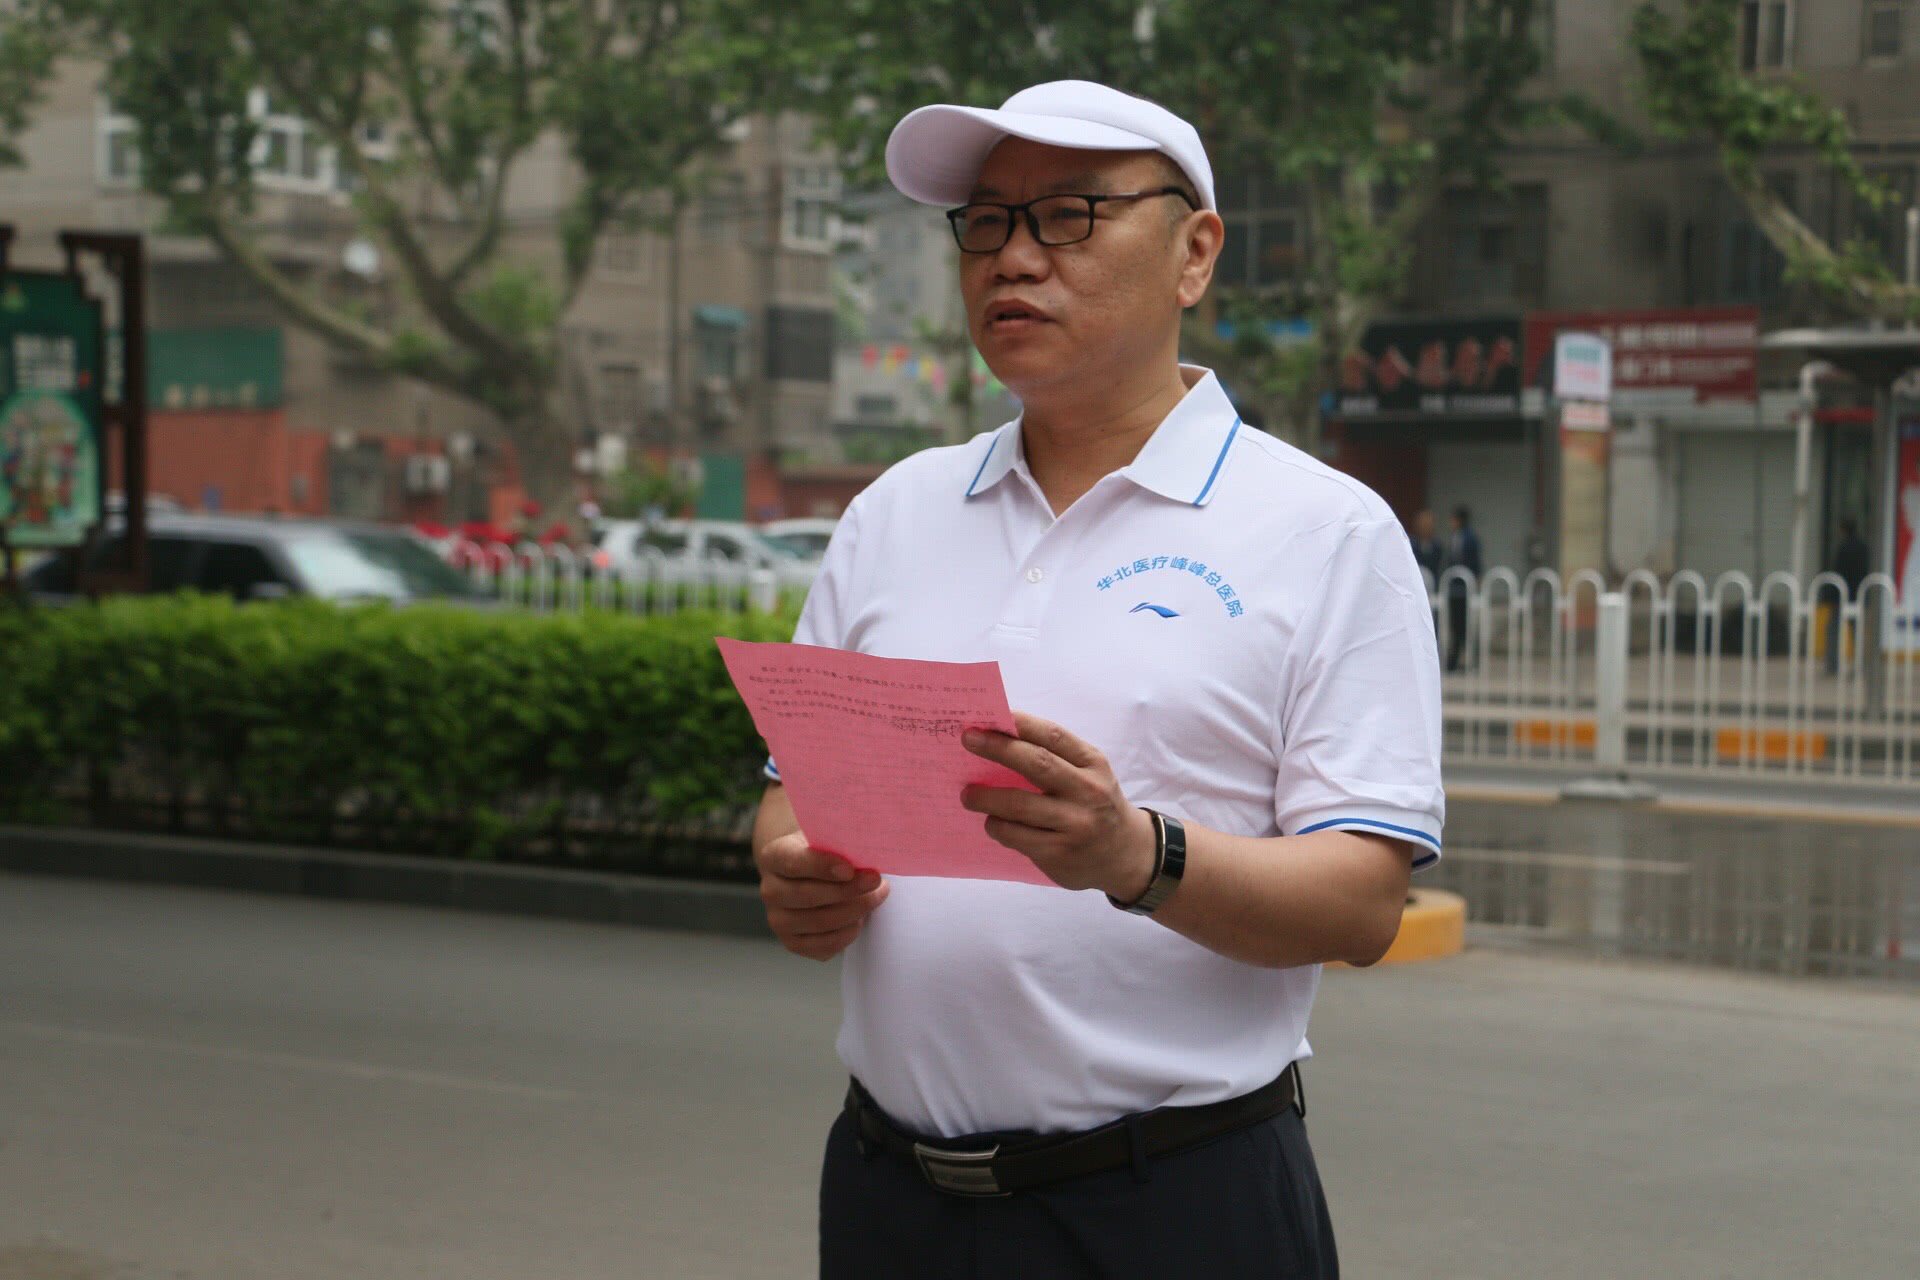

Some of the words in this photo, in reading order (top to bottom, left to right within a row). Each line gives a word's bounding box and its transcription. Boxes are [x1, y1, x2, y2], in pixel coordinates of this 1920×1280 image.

[1096, 555, 1244, 618] 华北医疗峰峰总医院
